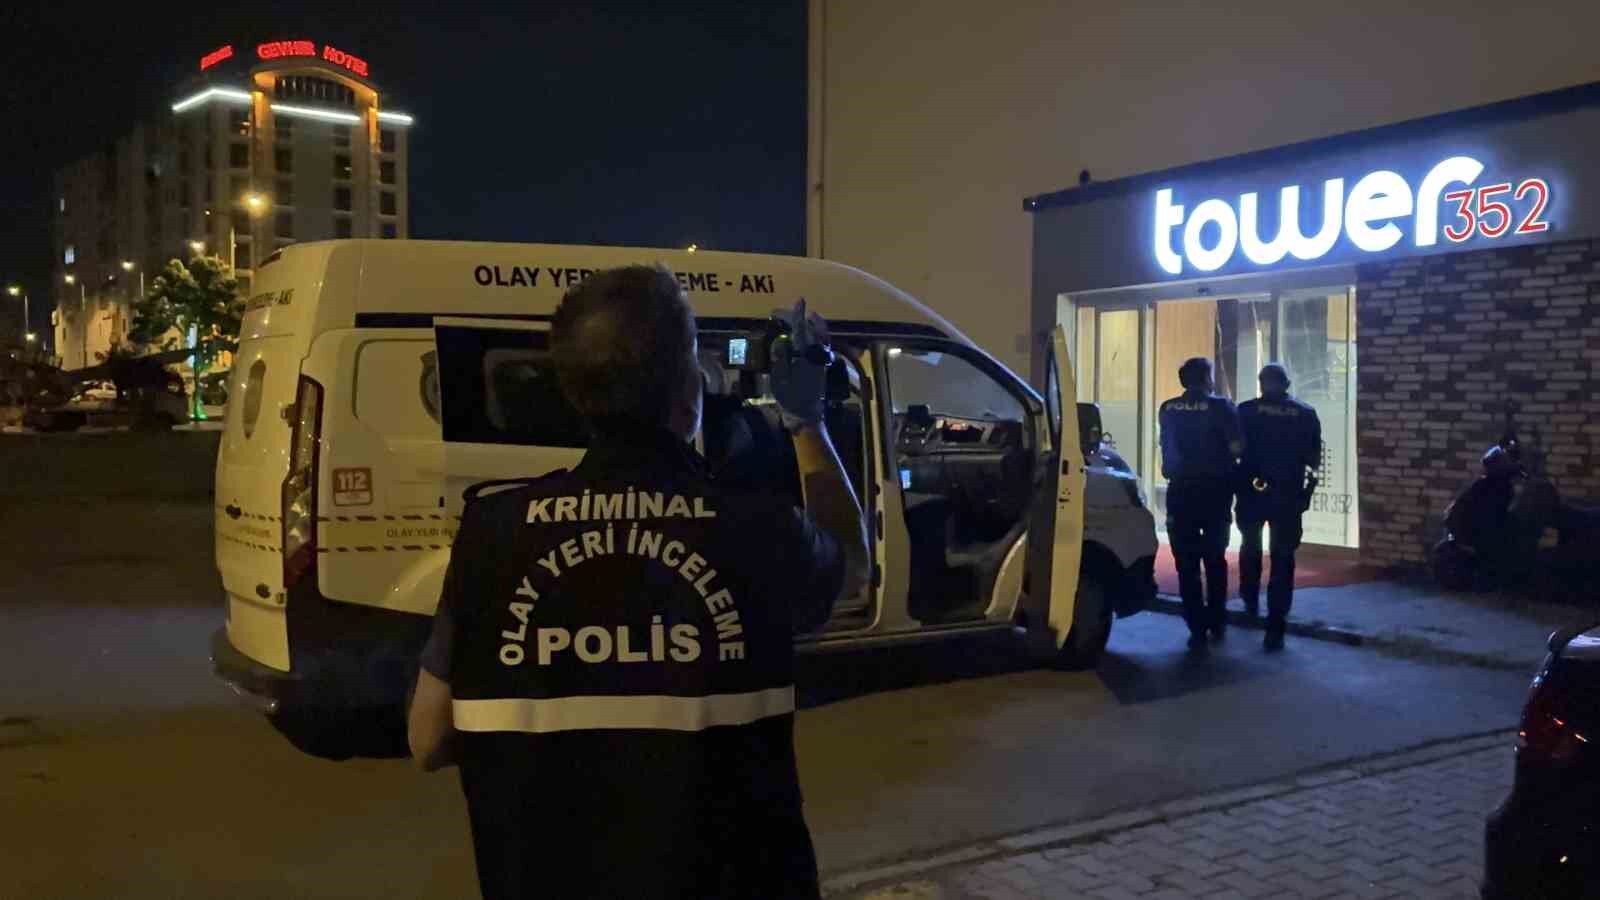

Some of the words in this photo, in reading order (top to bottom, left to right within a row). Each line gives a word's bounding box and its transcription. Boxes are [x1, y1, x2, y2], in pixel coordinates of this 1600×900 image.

[1154, 156, 1485, 275] tower
[1443, 178, 1550, 243] 352
[474, 265, 540, 287] OLAY
[337, 471, 367, 489] 112
[526, 486, 717, 523] KRİMİNAL
[499, 575, 540, 666] OLAY
[537, 522, 614, 577] YERİ
[627, 521, 745, 662] İNCELEME
[537, 615, 701, 665] POLİS
